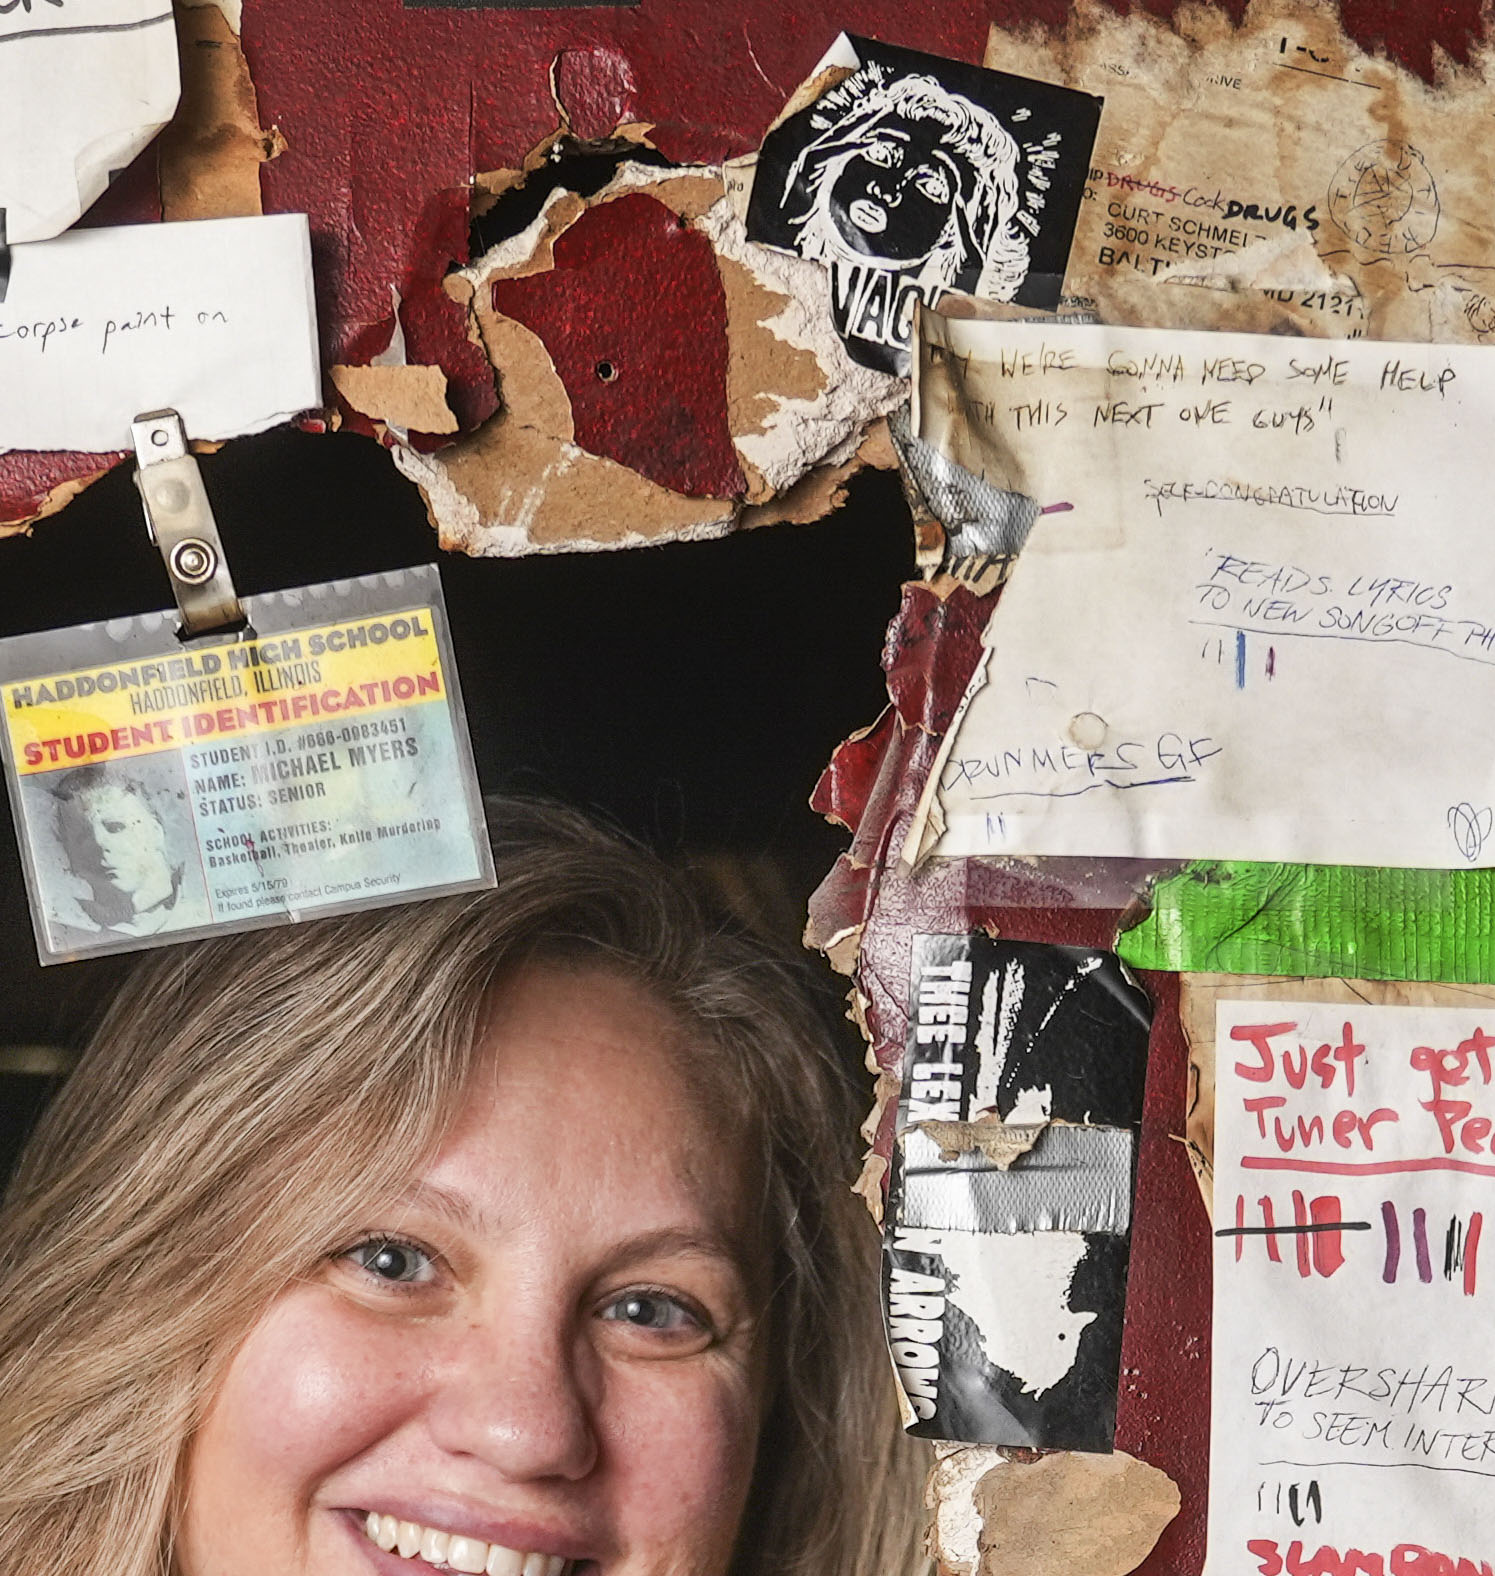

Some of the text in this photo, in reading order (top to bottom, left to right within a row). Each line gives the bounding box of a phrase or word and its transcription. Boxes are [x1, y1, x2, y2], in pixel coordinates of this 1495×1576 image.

[1103, 222, 1149, 245] 3600
[1107, 202, 1165, 226] CURT
[1222, 200, 1319, 230] DRUGS
[104, 306, 174, 352] paint
[196, 310, 228, 327] on
[1107, 352, 1185, 381] GONNA
[1202, 357, 1266, 385] NEED
[1287, 357, 1349, 387] SOME
[1380, 360, 1457, 398] HELP
[1008, 403, 1069, 427] THIS
[1094, 402, 1156, 429] NEXT
[1179, 402, 1230, 426] ONE
[1196, 584, 1230, 610] TO
[1243, 598, 1313, 623] NEW
[1348, 576, 1452, 609] LYRICS
[11, 616, 428, 709] HADDONFIELD HIGH SCHOOL
[254, 661, 322, 694] ILLINOIS
[24, 671, 440, 766] STUDENT IDENTIFICATION
[194, 737, 419, 794] NAME: MICHAEL MYERS
[199, 782, 327, 817] STATUS: SENIOR
[206, 820, 332, 853] SCHOOL ACTIVITIES:
[1229, 1020, 1365, 1097] Just
[1243, 1096, 1400, 1153] Tuner
[1301, 1408, 1391, 1447] SEEM
